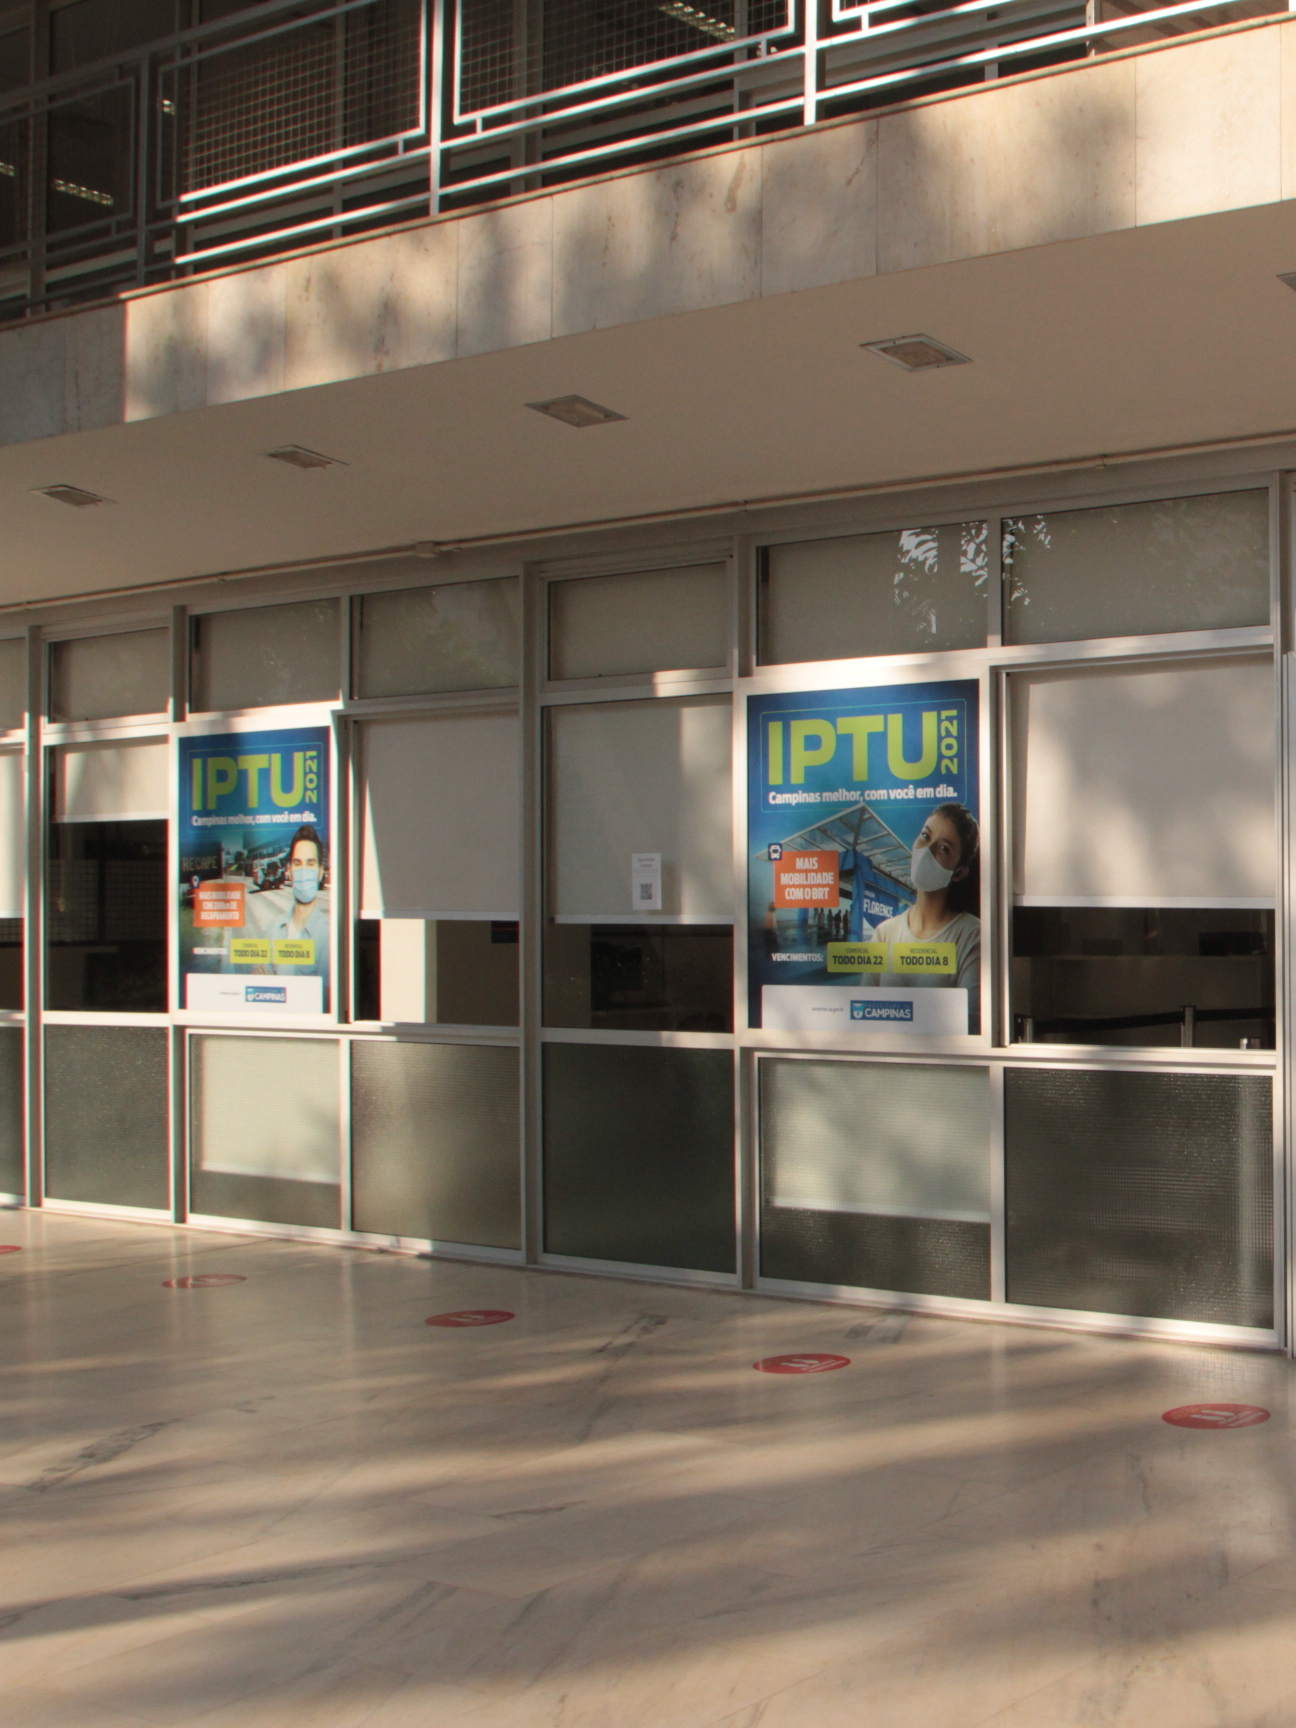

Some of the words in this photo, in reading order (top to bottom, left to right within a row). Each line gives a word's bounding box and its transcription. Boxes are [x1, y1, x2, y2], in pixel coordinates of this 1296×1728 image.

[768, 711, 938, 785] IPTU
[941, 709, 959, 775] 2021
[192, 751, 304, 811] IPTU
[305, 751, 318, 803] 2021
[768, 791, 821, 805] Campinas
[822, 788, 863, 802] melhor,
[864, 788, 888, 801] com
[889, 784, 915, 799] você
[916, 786, 935, 798] em
[935, 784, 958, 798] dia.
[192, 815, 228, 826] Campinas
[228, 813, 256, 825] melhor,
[255, 814, 271, 823] com
[272, 811, 289, 823] você
[289, 813, 301, 822] em
[302, 811, 317, 822] dia.
[796, 857, 818, 869] MAIS
[781, 872, 834, 885] MOBILIDADE
[785, 888, 804, 900] COM
[804, 888, 811, 899] O
[811, 888, 830, 899] BRT
[863, 898, 894, 918] FLORENCE
[234, 949, 250, 958] TODO
[250, 949, 260, 958] DIA
[278, 950, 295, 958] TODO
[294, 950, 305, 959] DIA
[771, 952, 824, 962] VENCIMENTOS:
[832, 955, 854, 965] TODO
[854, 955, 873, 965] DIA
[873, 956, 883, 965] 22
[900, 956, 925, 966] TODO
[925, 956, 942, 966] DIA
[942, 956, 949, 966] 8
[255, 992, 286, 1001] CAMPINAS
[865, 1008, 911, 1019] CAMPINAS
